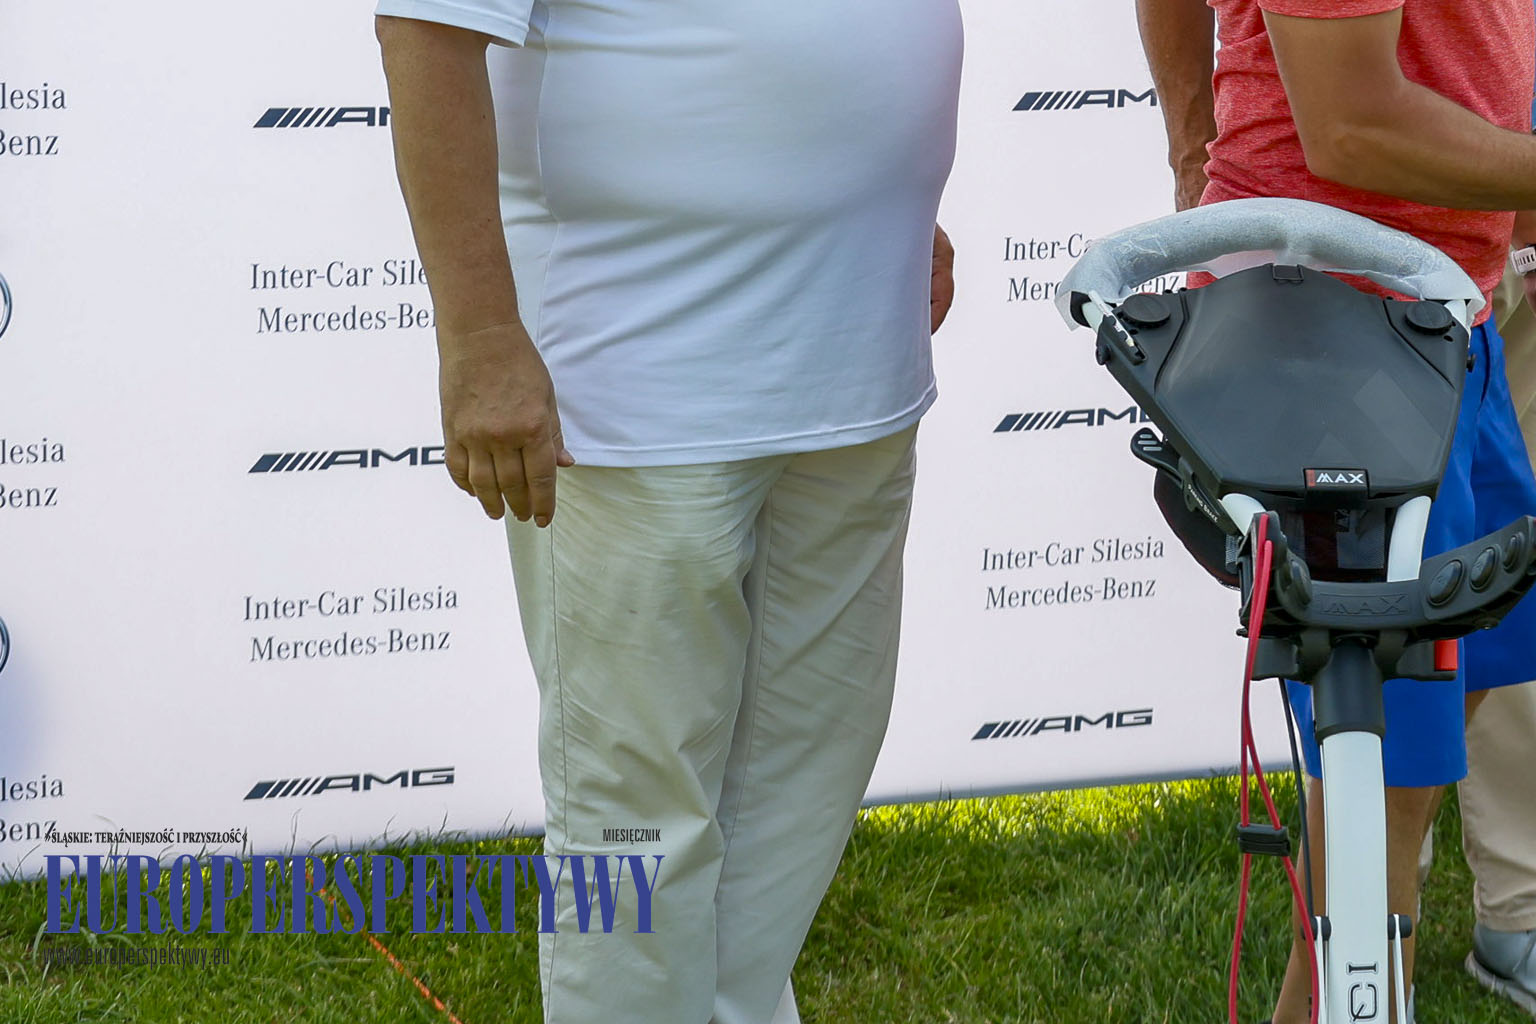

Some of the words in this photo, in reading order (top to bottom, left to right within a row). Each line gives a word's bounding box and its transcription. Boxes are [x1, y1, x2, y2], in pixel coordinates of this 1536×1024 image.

[1072, 87, 1158, 109] AM
[1003, 233, 1092, 261] Inter-C
[252, 262, 373, 289] Inter-Car
[382, 259, 427, 286] Sile
[257, 303, 435, 333] Mercedes-Be
[983, 544, 1084, 570] Inter-Car
[1092, 536, 1163, 562] Silesia
[245, 592, 363, 620] Inter-Car
[373, 586, 456, 612] Silesia
[986, 578, 1155, 609] Mercedes-Benz
[251, 629, 449, 661] Mercedes-Benz
[1043, 708, 1153, 732] AMG
[319, 766, 455, 794] AMG
